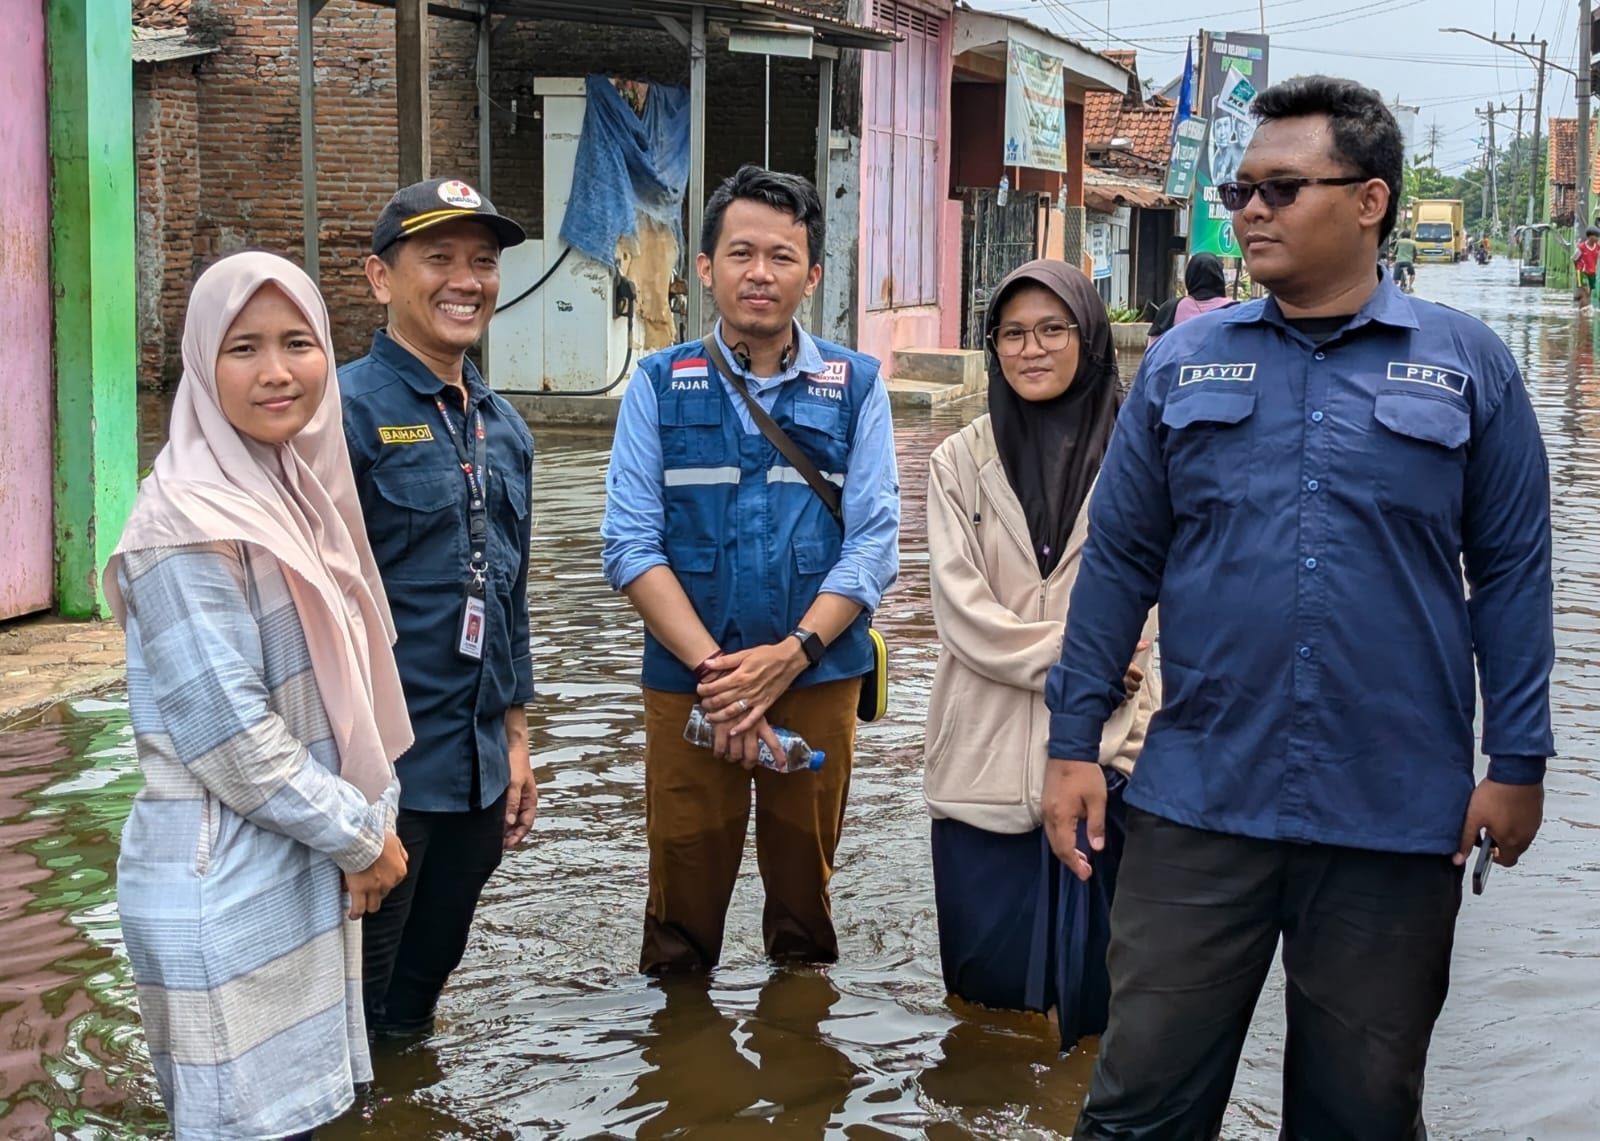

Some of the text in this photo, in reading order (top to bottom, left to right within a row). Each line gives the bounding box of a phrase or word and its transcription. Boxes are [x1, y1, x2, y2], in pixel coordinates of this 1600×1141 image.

[1192, 367, 1243, 380] BAYU
[1407, 367, 1448, 386] PPK
[671, 380, 709, 390] FAJAR
[807, 385, 842, 401] KETUA
